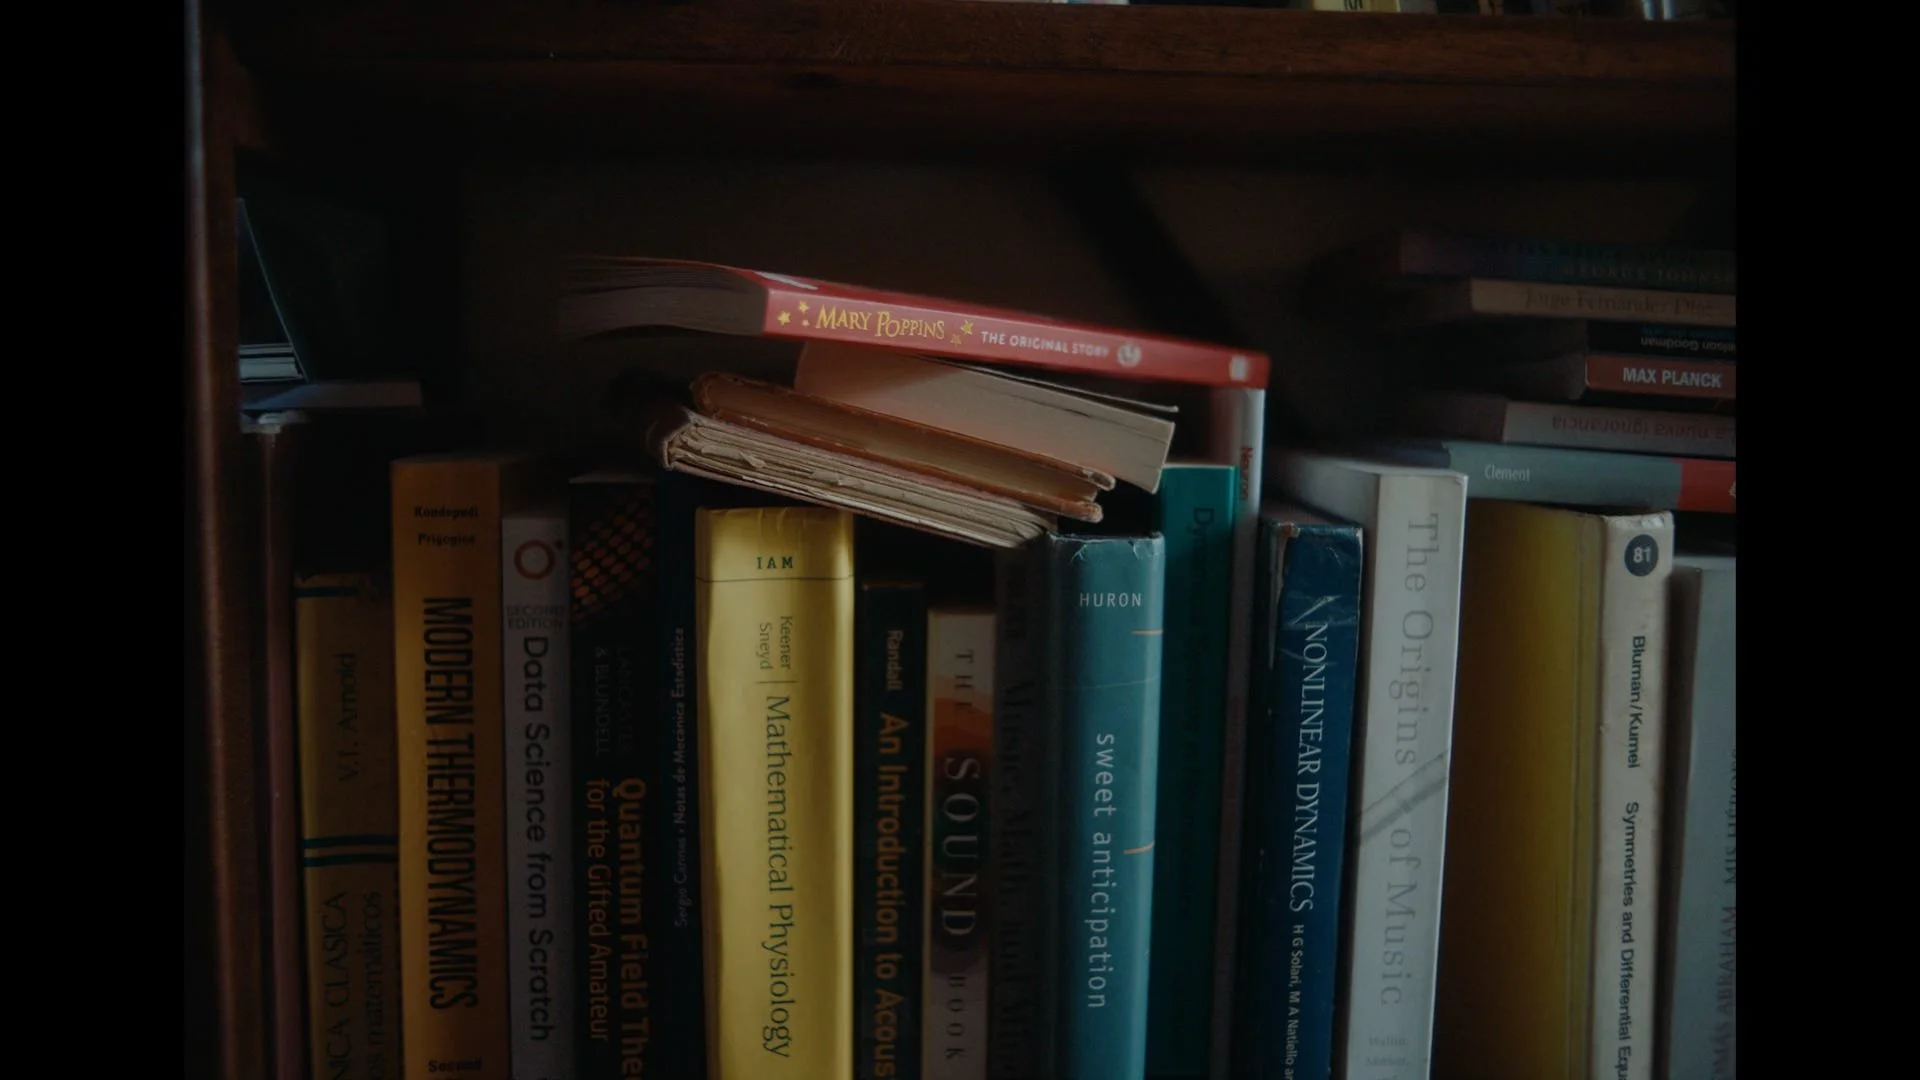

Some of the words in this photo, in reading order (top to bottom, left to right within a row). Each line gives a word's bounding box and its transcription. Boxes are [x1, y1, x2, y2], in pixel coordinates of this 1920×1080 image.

[815, 304, 873, 331] MARY
[874, 310, 945, 340] POPPINS
[980, 330, 1007, 346] THE
[1008, 334, 1069, 354] ORIGINAL
[1071, 342, 1110, 359] STORY
[1641, 335, 1698, 351] Goodman
[1623, 366, 1657, 385] MAX
[1661, 367, 1724, 389] PLANCK
[1484, 464, 1531, 482] Clement
[414, 504, 479, 520] Kondepudi
[417, 532, 476, 547] Prigogine
[1406, 512, 1440, 593] The
[1632, 547, 1651, 564] 81
[507, 617, 563, 629] EDITION
[1079, 592, 1142, 608] HURON
[423, 597, 474, 725] MODERN
[523, 636, 549, 712] Data
[755, 622, 773, 671] Sneyd
[779, 615, 794, 670] Keener
[337, 651, 357, 734] Arnold
[593, 663, 611, 758] BLUNDELL
[954, 648, 974, 715] THE
[1297, 622, 1329, 777] NONLINEAR
[1388, 609, 1434, 765] Origins
[1628, 635, 1646, 769] Bluman/Kumei
[878, 711, 909, 749] An
[525, 721, 553, 843] Science
[586, 777, 611, 810] for
[672, 768, 687, 784] de
[673, 786, 688, 825] Notas
[766, 695, 795, 895] Mathematical
[1094, 733, 1117, 817] sweet
[426, 731, 479, 1011] THERMODYNAMICS
[586, 819, 612, 859] the
[612, 776, 647, 926] Quantum
[875, 764, 908, 944] Introduction
[941, 756, 981, 937] SOUND
[1289, 783, 1320, 913] DYNAMICS
[1390, 827, 1422, 872] of
[1621, 801, 1639, 907] Symmetries
[527, 851, 554, 919] from
[587, 863, 613, 937] Gifted
[674, 888, 692, 928] Sergio
[1084, 831, 1117, 1009] anticipation
[1291, 937, 1305, 947] G
[1292, 923, 1305, 934] H
[1380, 881, 1418, 1007] Music
[1621, 912, 1635, 944] and
[529, 928, 555, 1041] Scratch
[588, 943, 613, 1042] Amateur
[620, 932, 649, 1010] Field
[761, 903, 796, 1058] Physiology
[873, 952, 903, 980] to
[1288, 949, 1304, 987] Solari,
[1716, 906, 1736, 1014] ABRAHAM
[944, 974, 966, 1062] BOOK
[1288, 990, 1301, 1003] M
[1288, 1006, 1301, 1016] A
[1618, 948, 1635, 1041] Differential
[620, 1016, 650, 1080] The
[1284, 1019, 1300, 1066] Natiello
